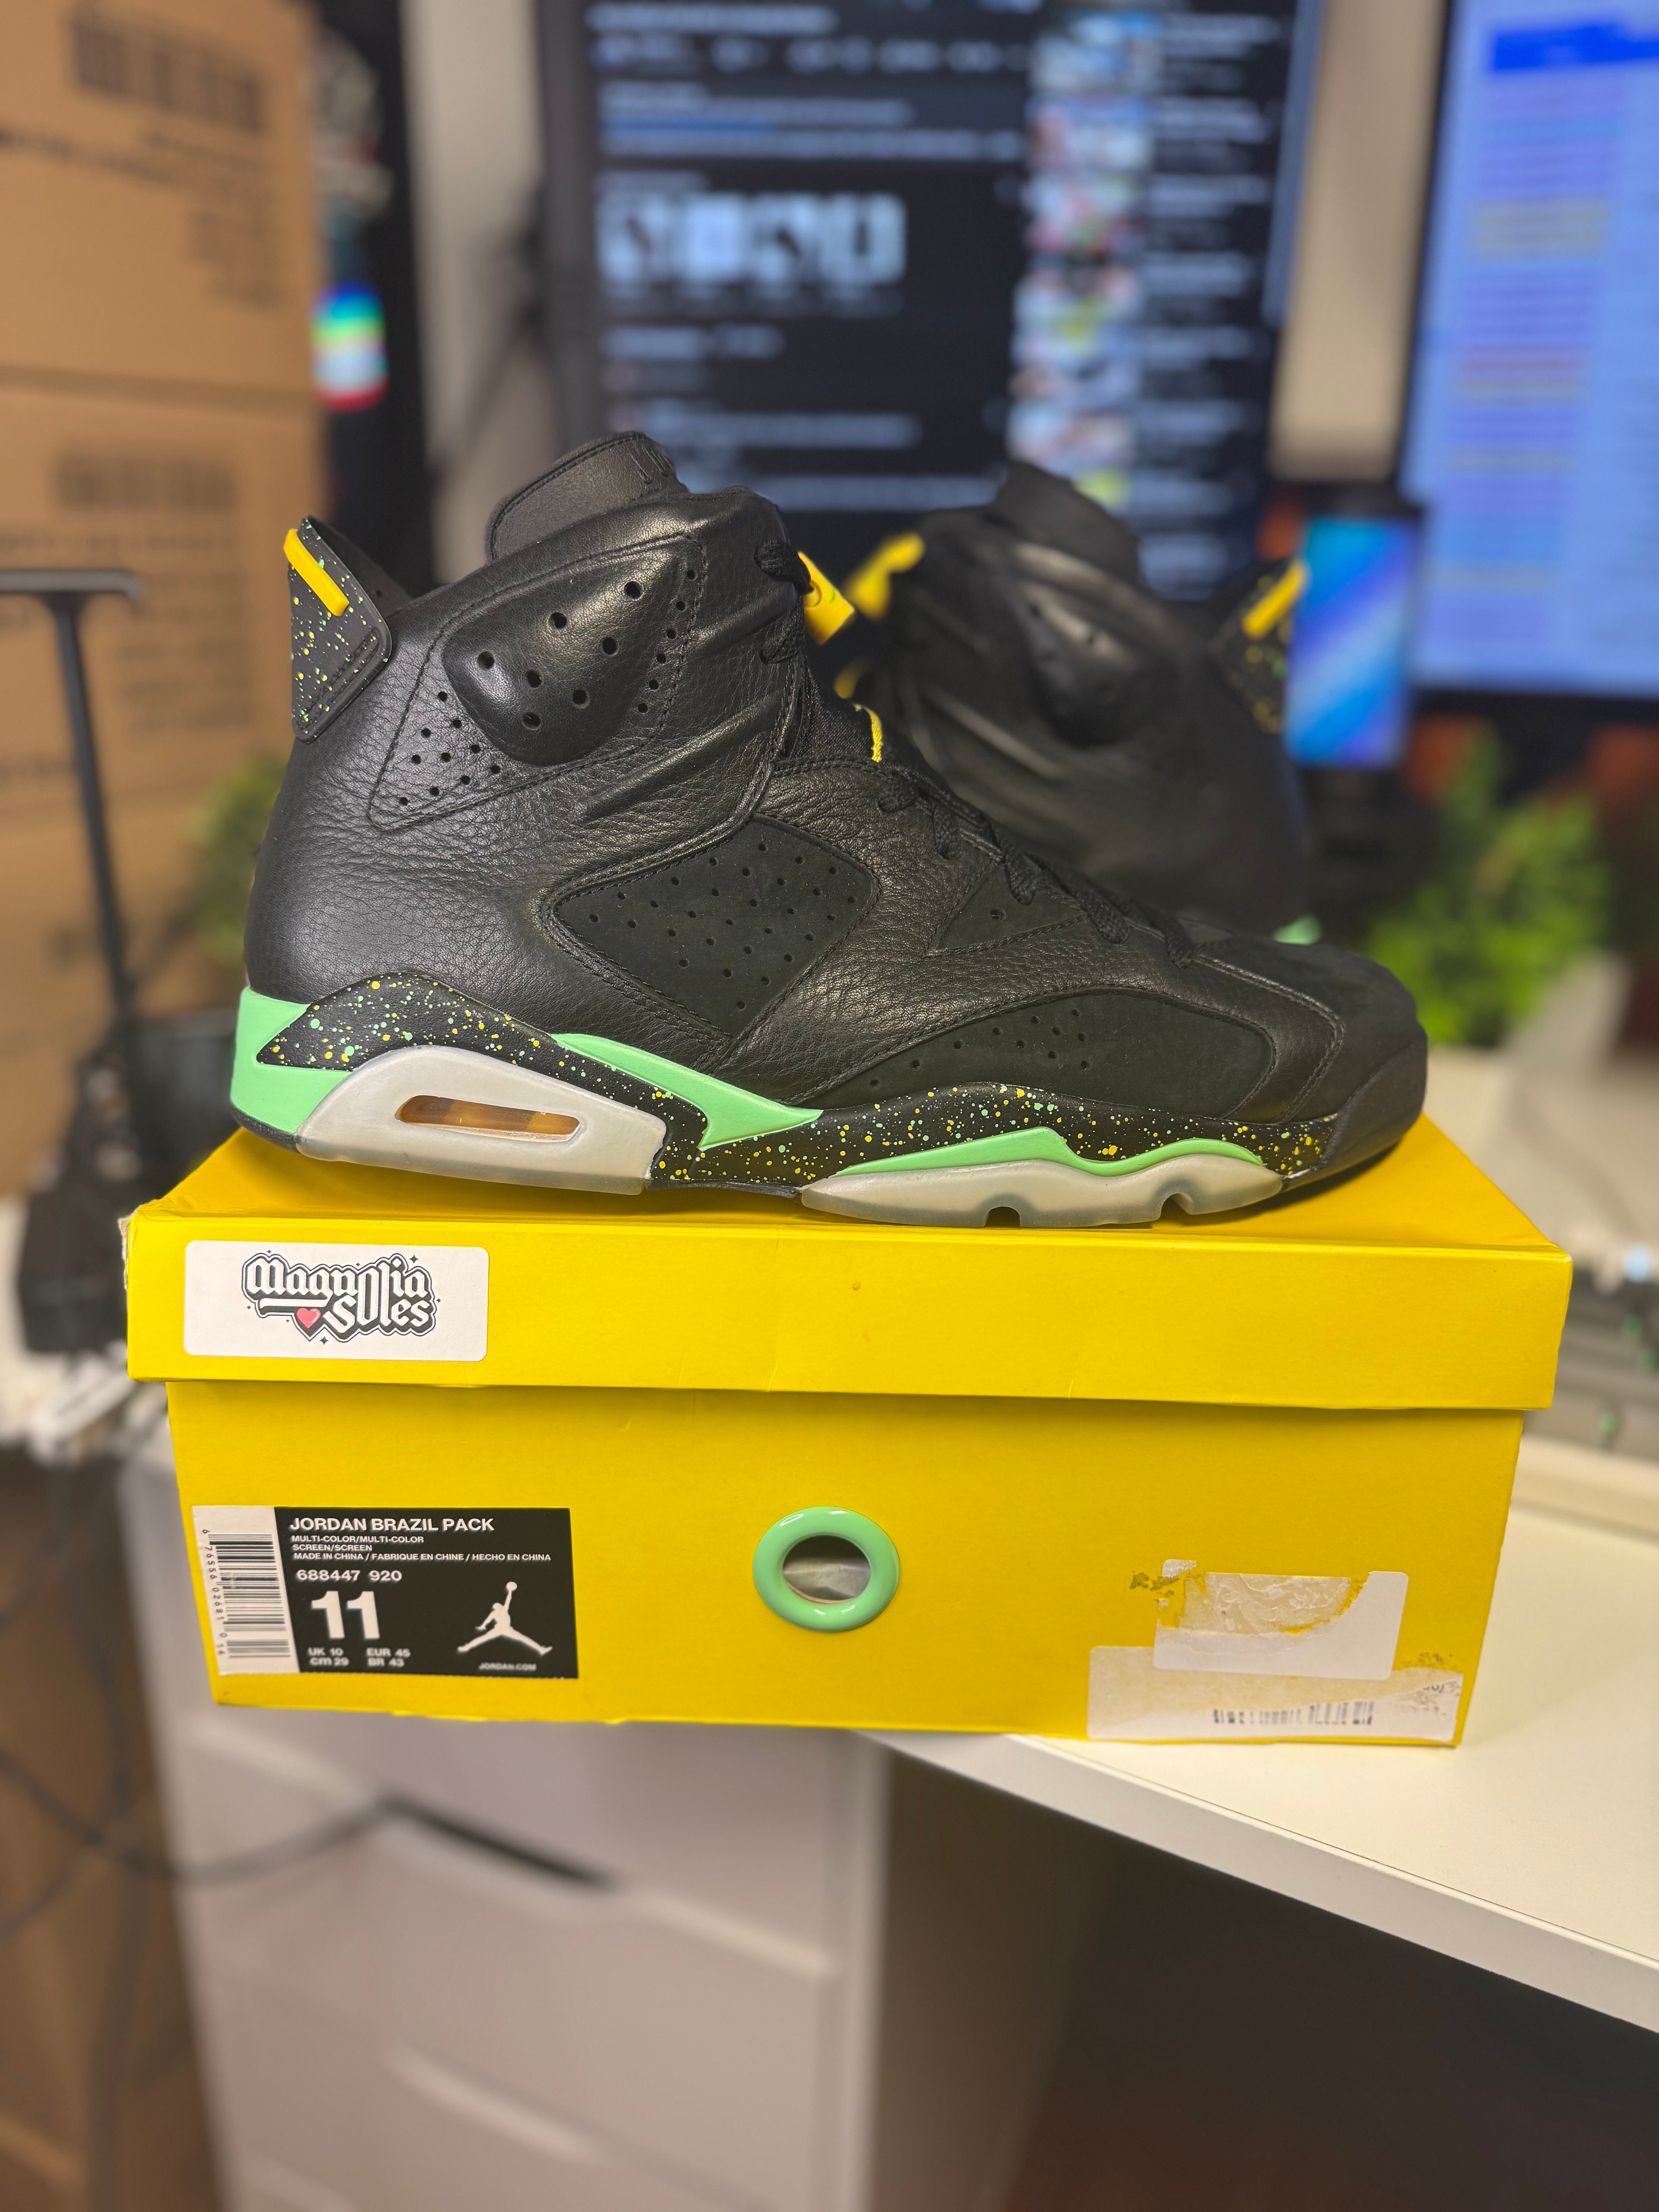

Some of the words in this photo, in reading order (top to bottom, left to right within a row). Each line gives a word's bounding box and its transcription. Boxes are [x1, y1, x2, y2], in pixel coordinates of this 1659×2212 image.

[290, 1518, 367, 1531] JORDAN
[371, 1518, 439, 1531] BRAZIL
[443, 1518, 495, 1531] PACK
[291, 1535, 424, 1544] MULTI-COLOR/MULTI-COLOR
[205, 1546, 218, 1580] 76556
[297, 1569, 361, 1581] 688447
[369, 1570, 403, 1581] 920
[213, 1587, 225, 1620] 02681
[311, 1591, 380, 1639] 11
[308, 1647, 326, 1656] UK
[330, 1648, 344, 1656] 10
[366, 1648, 391, 1657] EUR
[395, 1648, 411, 1658] 45
[309, 1657, 332, 1666] cm
[334, 1657, 350, 1666] 29
[367, 1658, 385, 1667] BR
[388, 1658, 405, 1668] 43
[478, 1662, 537, 1671] JORDAN.COM
